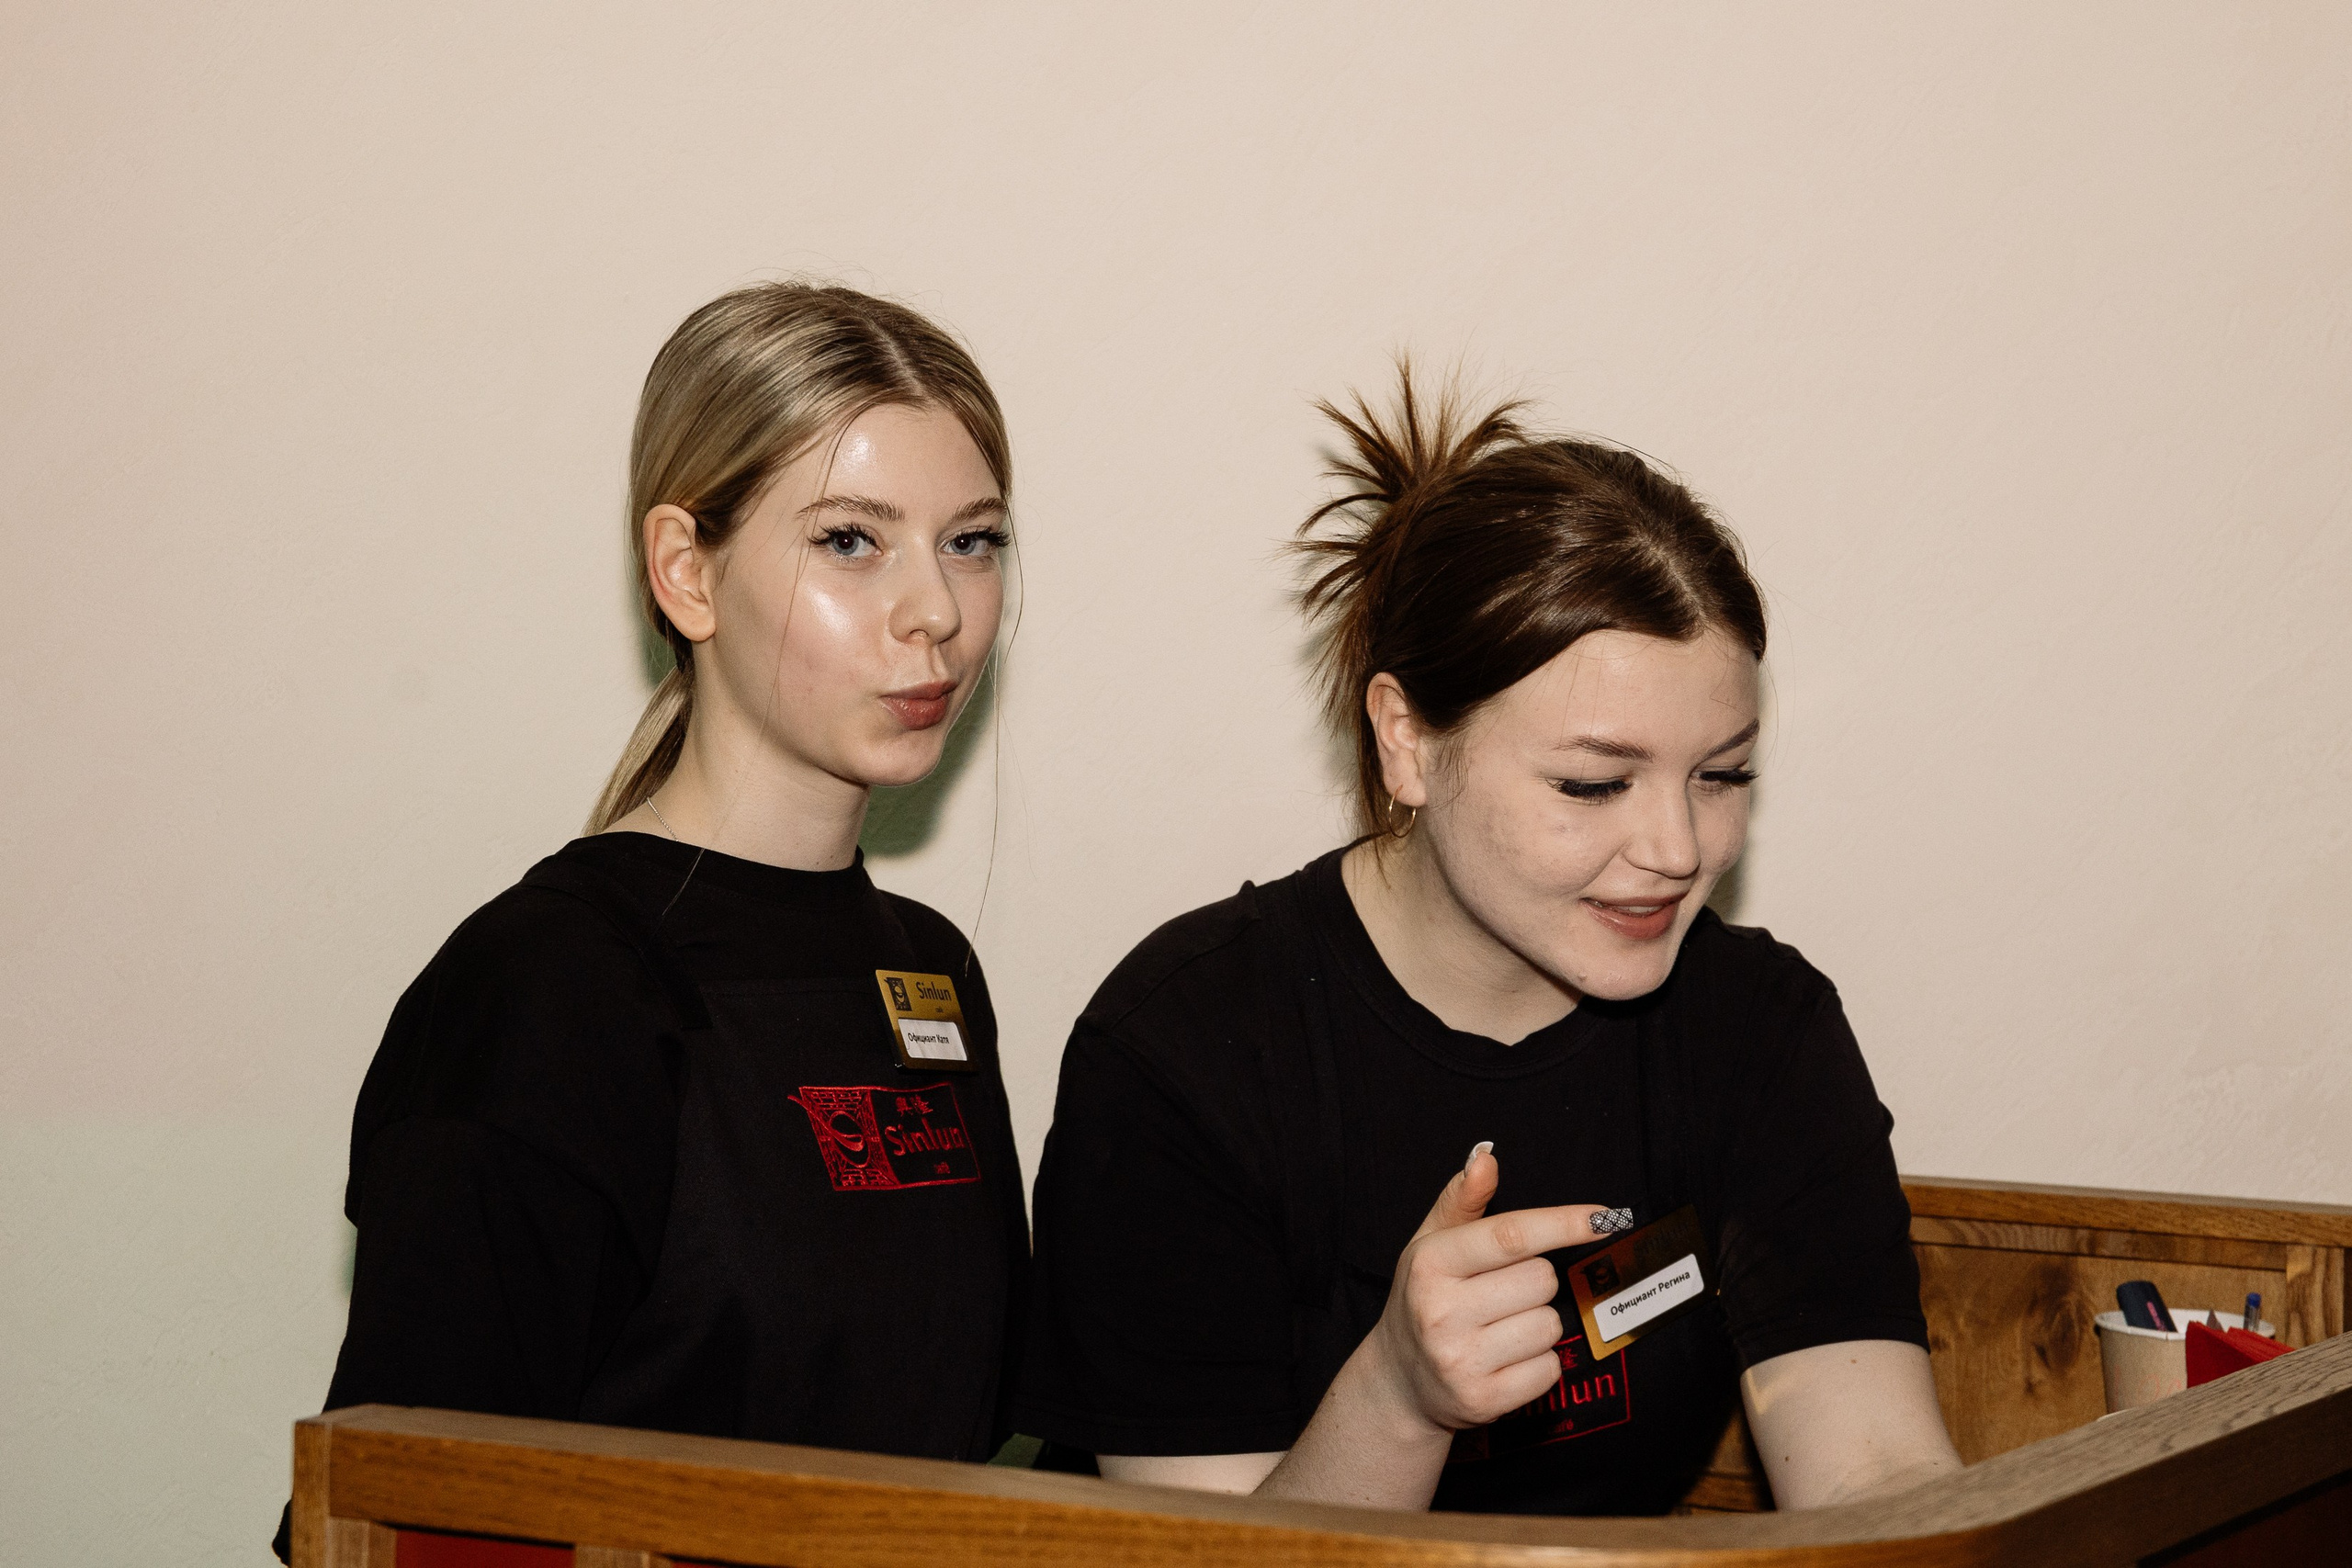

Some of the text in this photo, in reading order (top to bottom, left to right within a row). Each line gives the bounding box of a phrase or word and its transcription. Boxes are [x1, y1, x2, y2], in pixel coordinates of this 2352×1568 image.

[916, 982, 952, 1001] Sinlun
[908, 1032, 936, 1043] Официант
[885, 1117, 964, 1156] Sinlun
[1610, 1271, 1690, 1316] Официант Регина
